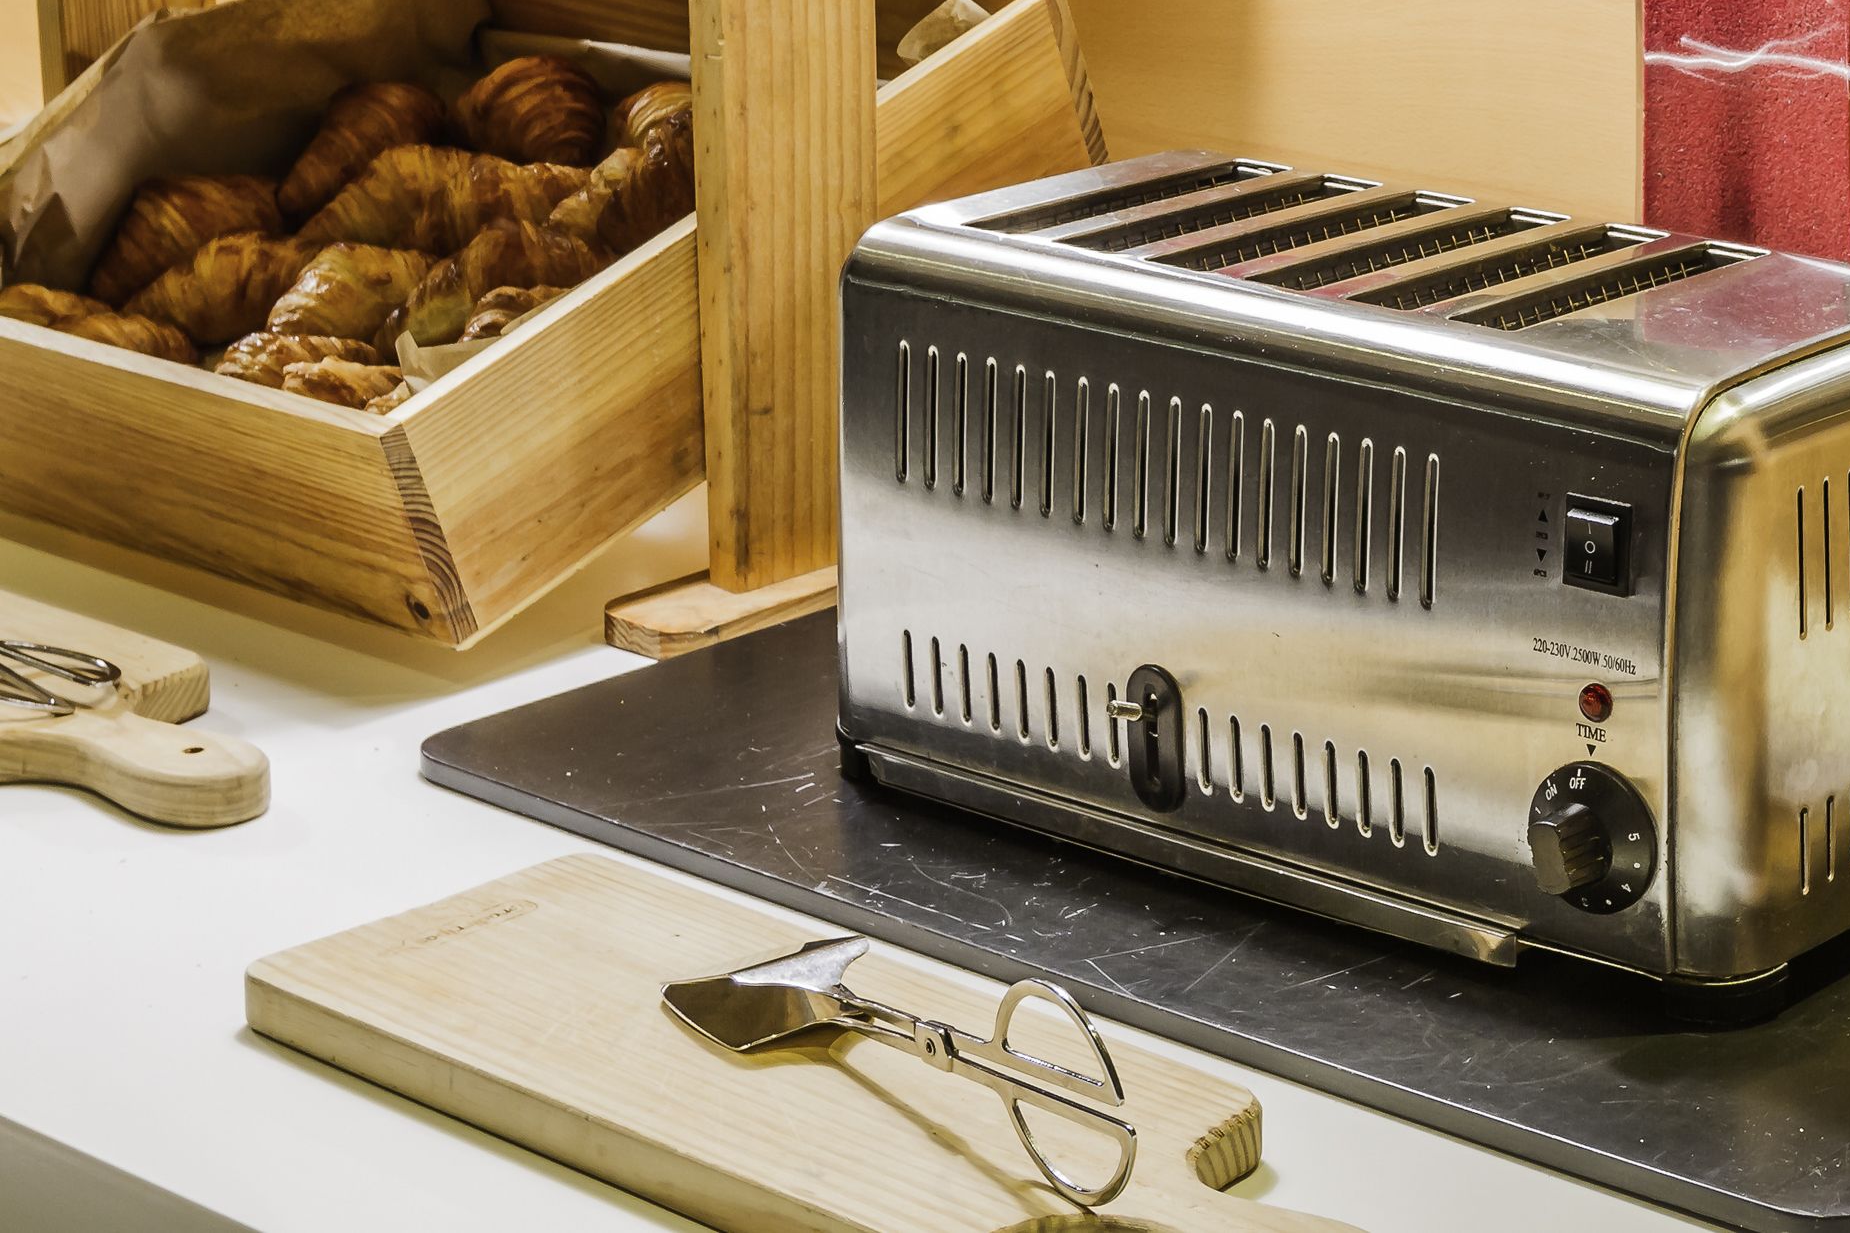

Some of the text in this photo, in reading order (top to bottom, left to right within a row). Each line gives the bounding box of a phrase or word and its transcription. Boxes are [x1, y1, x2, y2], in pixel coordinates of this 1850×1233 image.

[1576, 722, 1607, 743] TIME
[1569, 777, 1586, 790] OFF
[1545, 783, 1558, 801] ON
[1628, 832, 1640, 841] 5
[1620, 882, 1632, 893] 4
